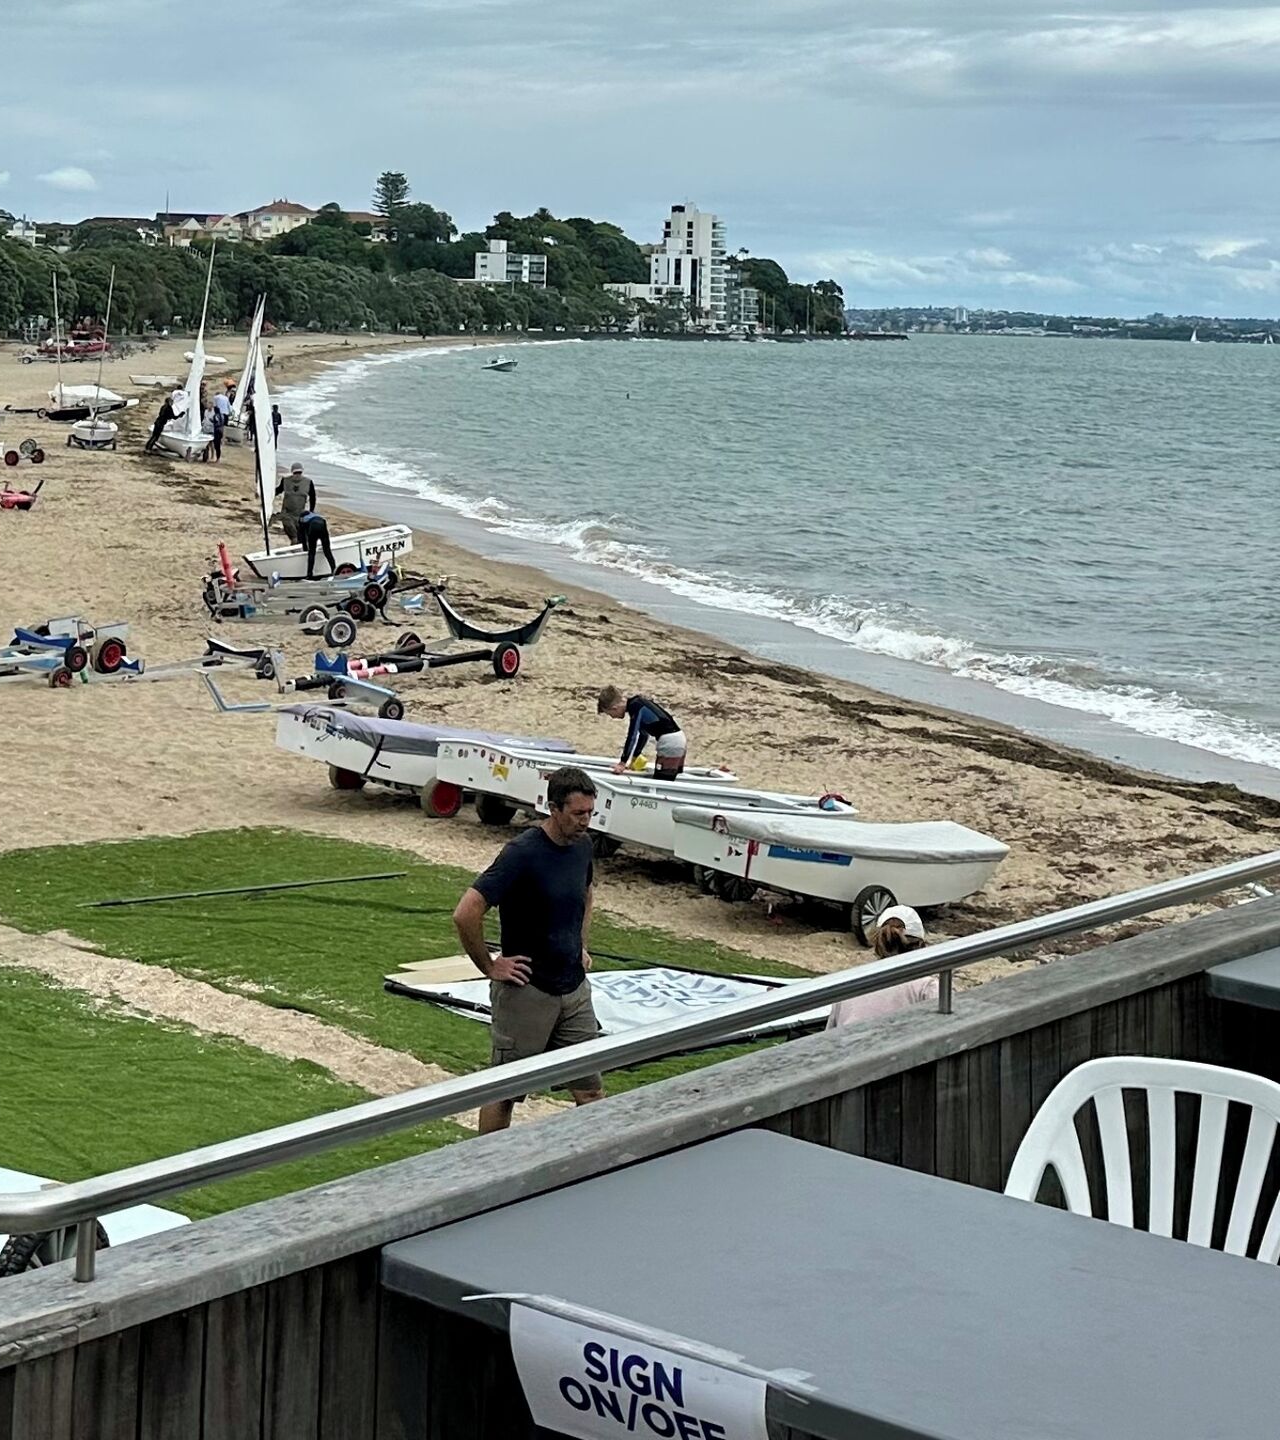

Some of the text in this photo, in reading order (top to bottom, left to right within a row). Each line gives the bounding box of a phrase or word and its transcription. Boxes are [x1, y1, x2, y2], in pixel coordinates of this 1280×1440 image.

[365, 540, 406, 556] KRAKEN
[584, 1342, 685, 1409] SIGN
[558, 1376, 726, 1440] ON/OFF
